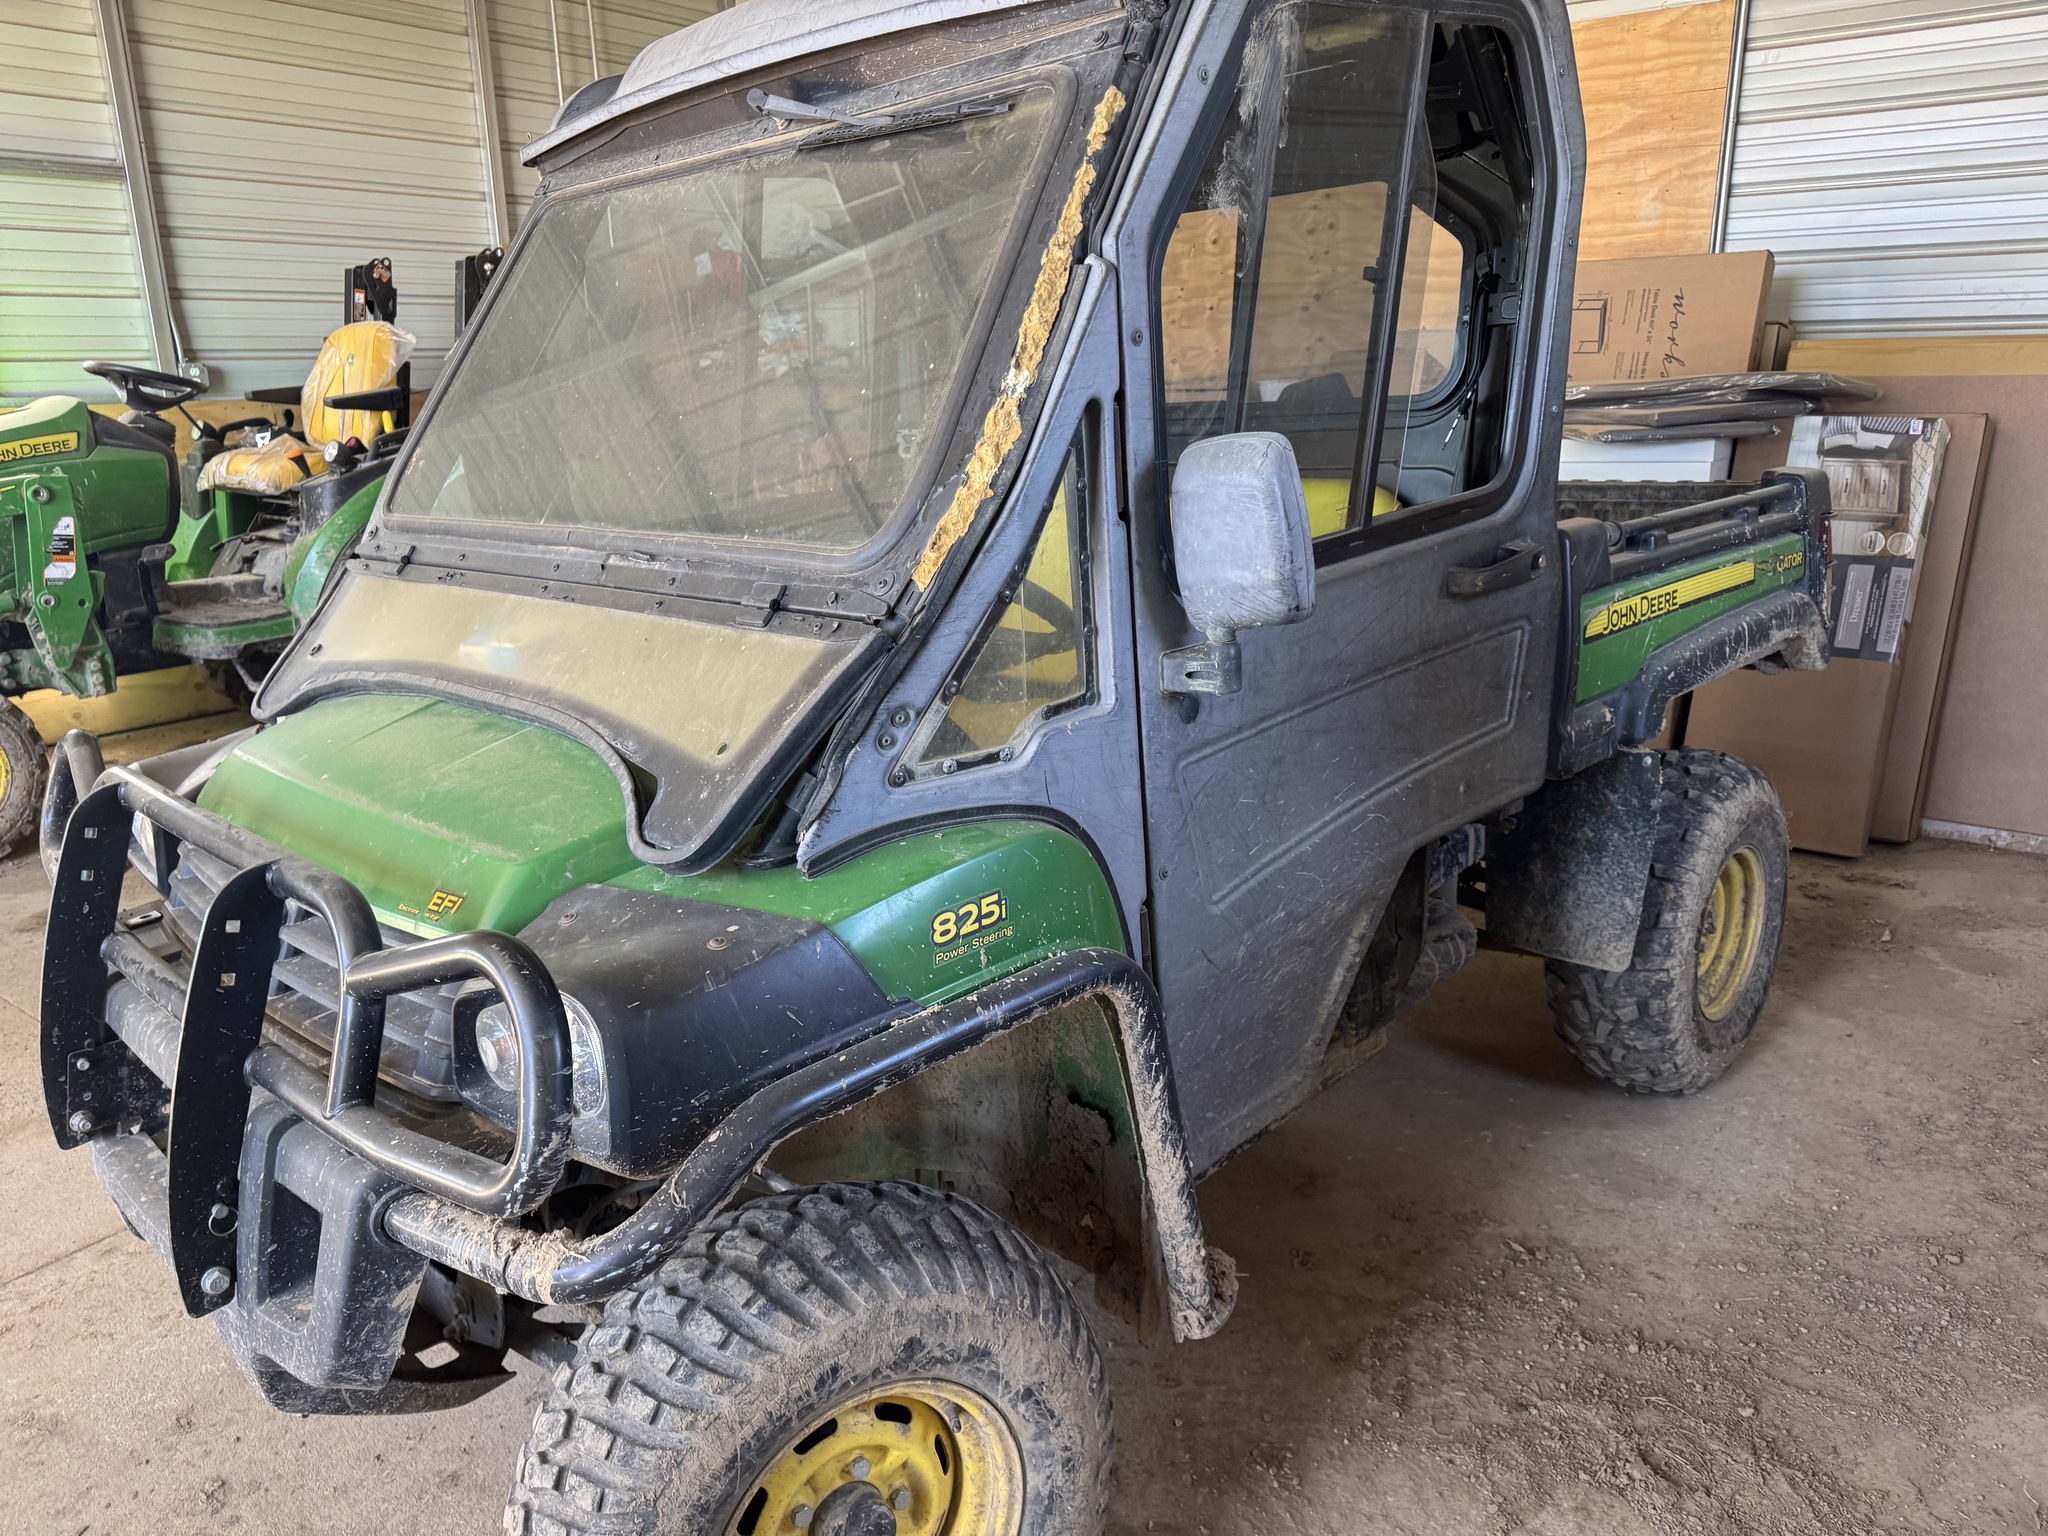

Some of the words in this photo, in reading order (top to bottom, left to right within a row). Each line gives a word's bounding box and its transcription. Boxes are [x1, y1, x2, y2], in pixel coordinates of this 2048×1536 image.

[1652, 288, 1661, 304] Table
[1650, 304, 1658, 319] Desk
[20, 439, 72, 456] DEERE
[1776, 551, 1803, 573] GATOR
[1603, 602, 1638, 630] JOHN
[1641, 589, 1679, 618] DEERE
[1849, 589, 1864, 623] Dresser
[428, 890, 464, 915] EFI
[933, 893, 1006, 944] 825i
[935, 943, 969, 965] Power
[972, 925, 1014, 949] Steering
